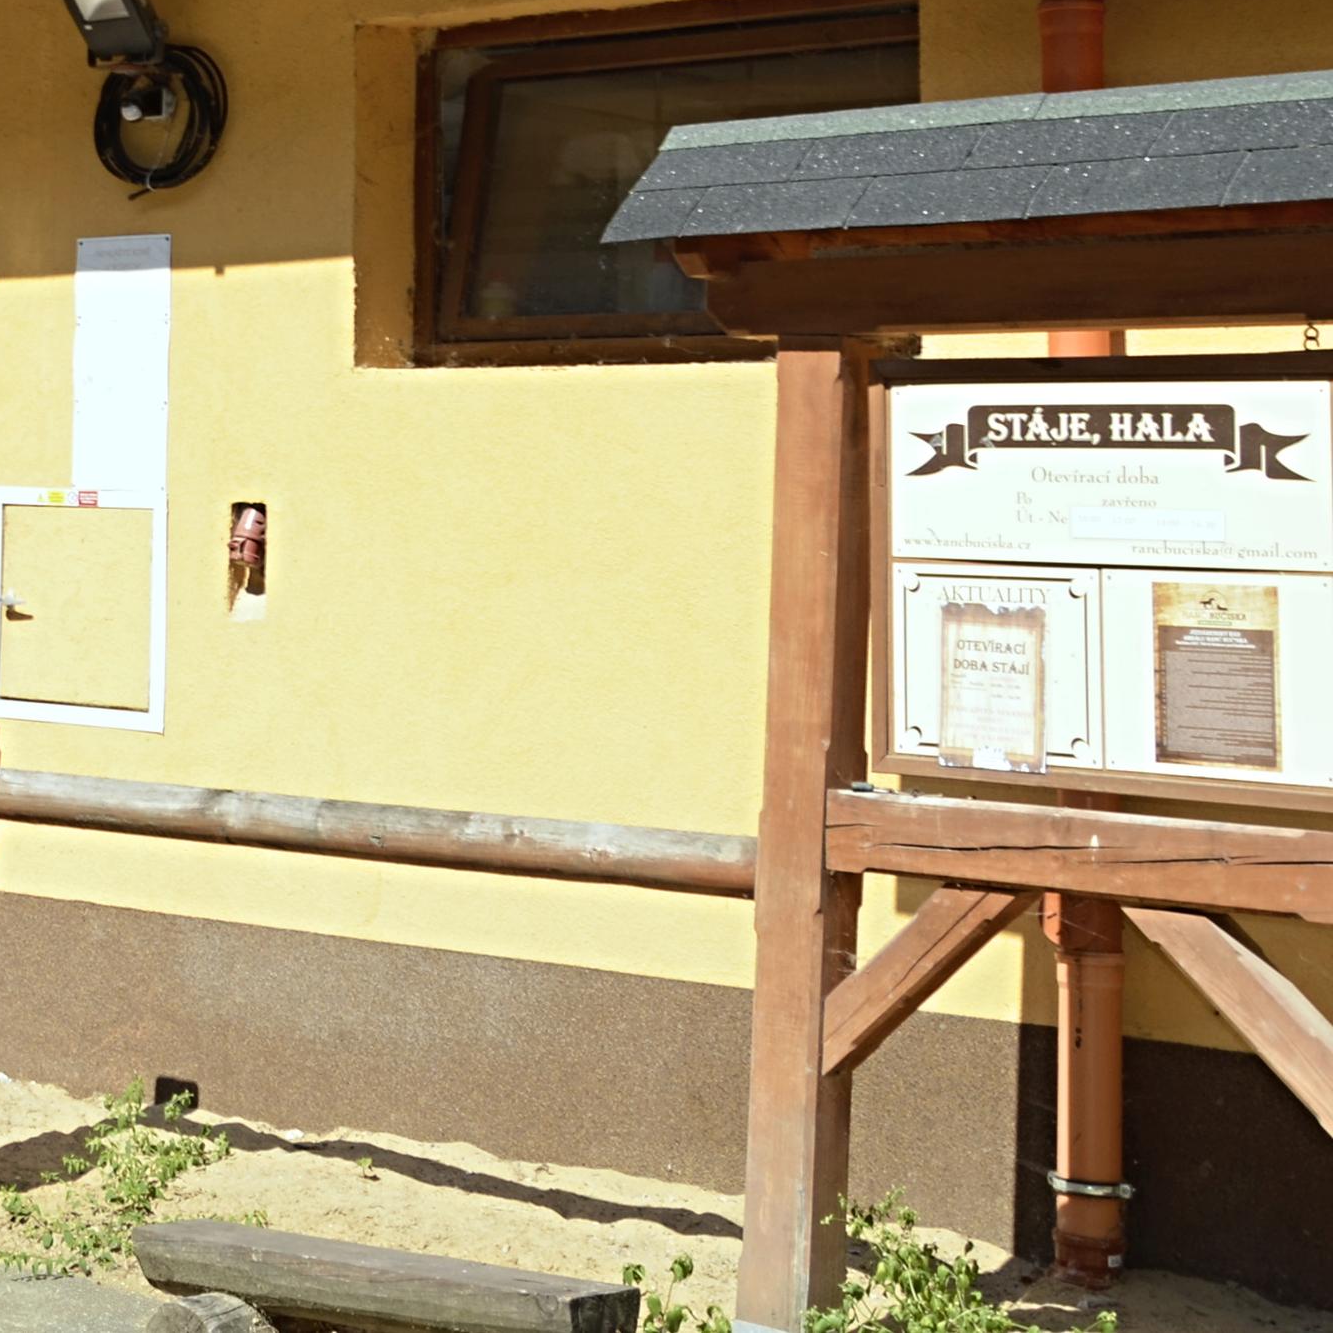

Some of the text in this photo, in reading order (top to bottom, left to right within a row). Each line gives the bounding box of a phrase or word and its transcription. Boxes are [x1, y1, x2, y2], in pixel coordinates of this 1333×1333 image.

[986, 407, 1215, 444] STÁJE, HALA
[1031, 464, 1159, 484] Otevírací doba
[1016, 491, 1033, 505] Po
[937, 585, 1051, 604] AKTUALITY
[956, 638, 1027, 655] OTEVÍRACÍ
[953, 658, 988, 672] DOBA
